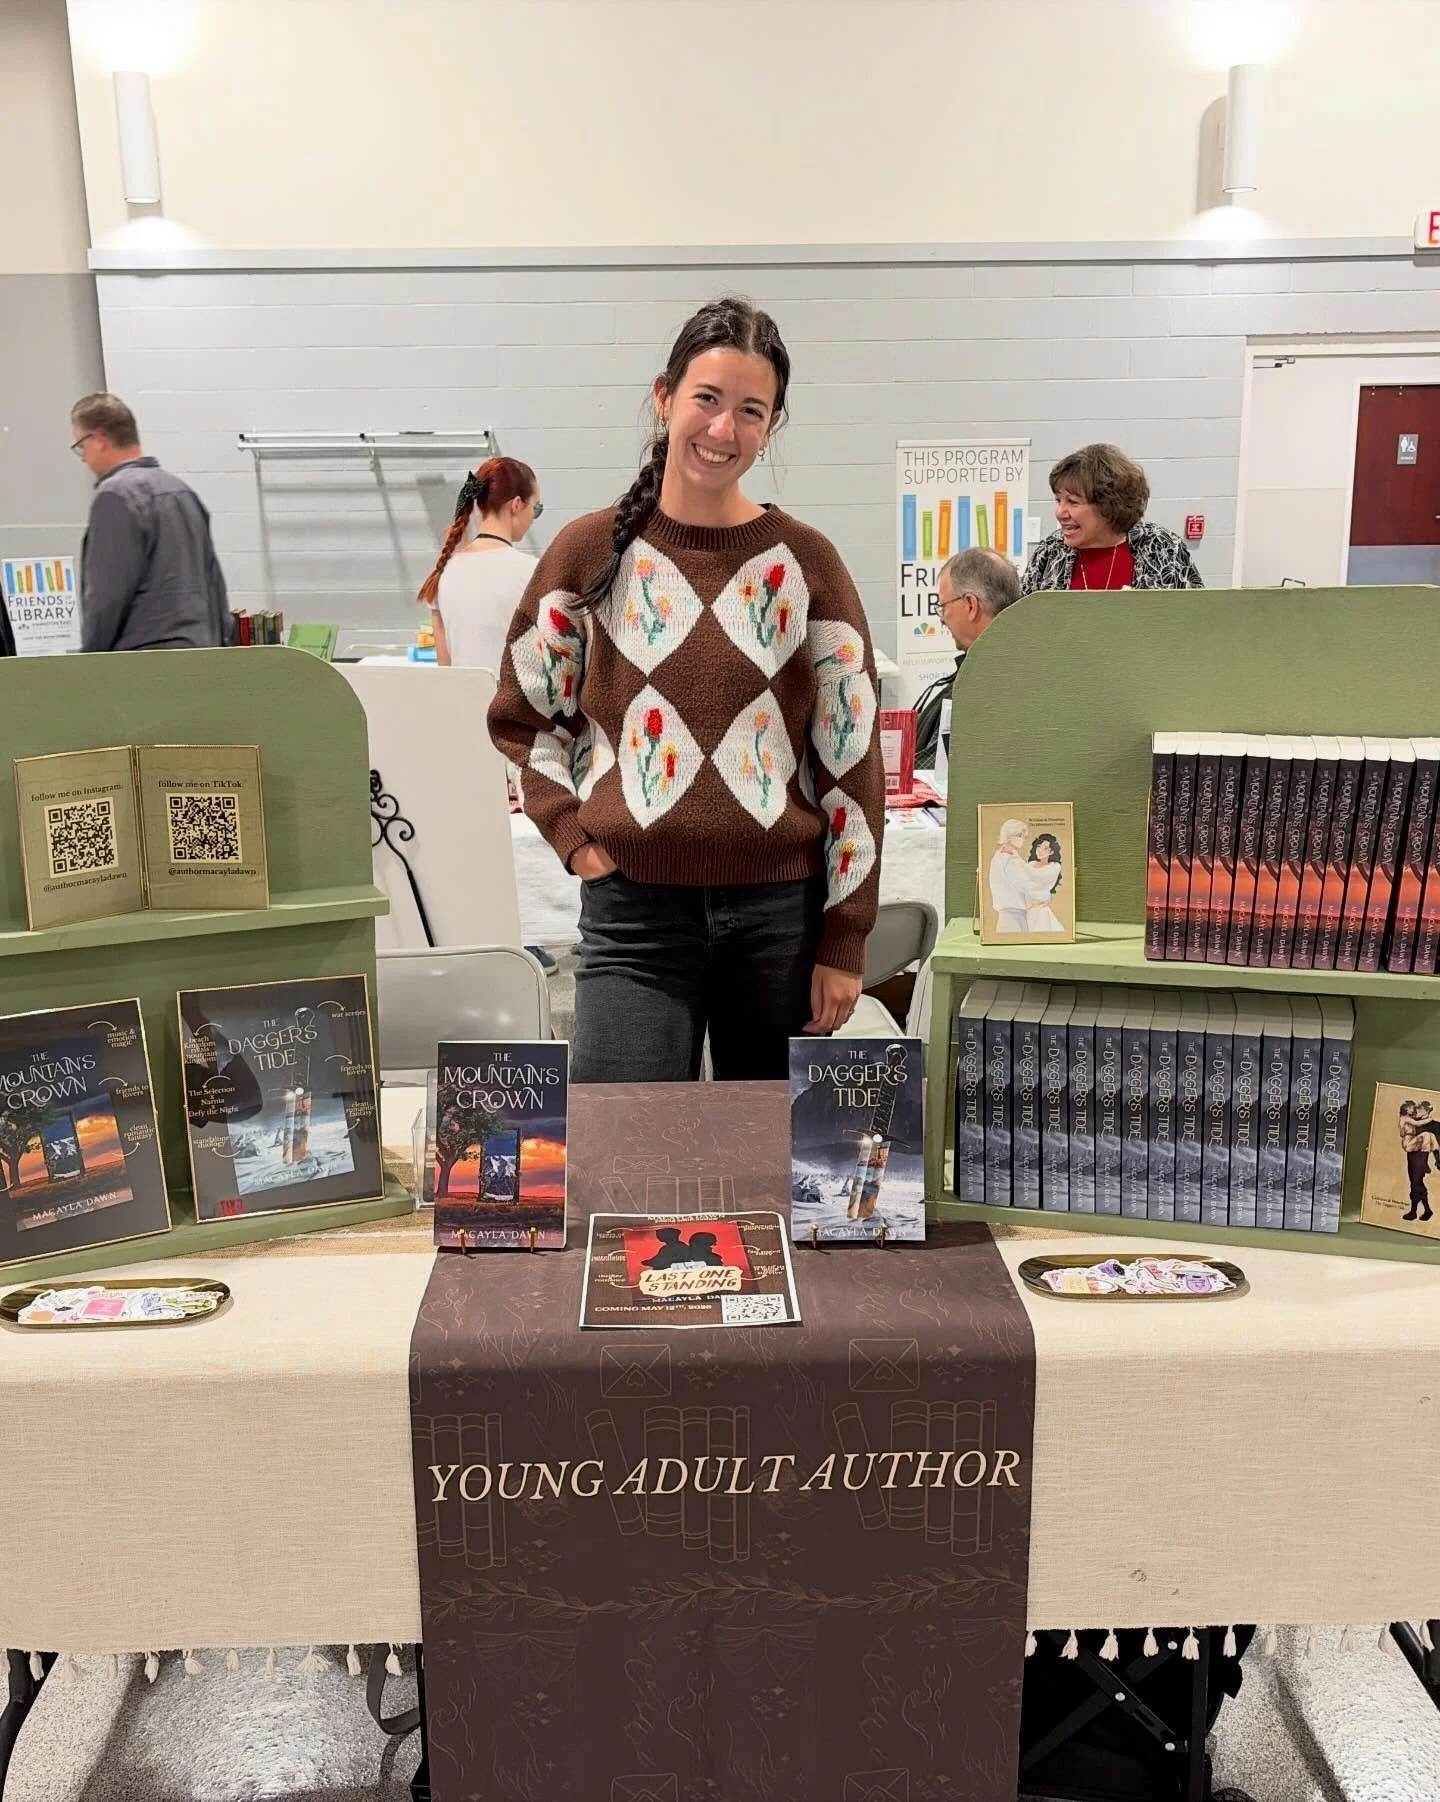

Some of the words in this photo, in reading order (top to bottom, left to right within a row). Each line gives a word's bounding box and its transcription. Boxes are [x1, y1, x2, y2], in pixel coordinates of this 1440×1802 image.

[904, 450, 940, 467] THIS
[944, 449, 1024, 465] PROGRAM
[903, 467, 1000, 485] SUPPORTED
[1006, 466, 1025, 482] BY
[8, 594, 63, 607] FRIENDS
[9, 607, 74, 622] LIBRARY
[158, 780, 184, 788] follow
[31, 792, 56, 802] follow
[168, 867, 257, 876] @authormacayladawn
[263, 1018, 280, 1028] THE
[107, 1031, 127, 1039] music
[107, 1034, 137, 1044] emotion
[111, 1040, 133, 1048] magic
[32, 1051, 50, 1063] THE
[254, 1048, 298, 1071] TIDE
[493, 1052, 513, 1062] THE
[848, 1050, 868, 1060] THE
[340, 1063, 361, 1073] friends
[444, 1063, 560, 1088] MOUNTAIN'S
[808, 1061, 908, 1086] DAGGER'S
[8, 1076, 88, 1110] CROWN
[115, 1085, 140, 1096] friends
[122, 1090, 144, 1099] lovers
[188, 1089, 203, 1097] The
[204, 1086, 236, 1095] Selection
[833, 1087, 881, 1107] TIDE
[456, 1086, 544, 1113] CROWN
[188, 1109, 206, 1118] Defy
[220, 1105, 240, 1114] Night
[964, 1098, 977, 1129] TIDE
[991, 1103, 1004, 1130] TIDE
[1020, 1103, 1034, 1130] TIDE
[1047, 1106, 1060, 1134] TIDE
[1073, 1109, 1087, 1137] TIDE
[1101, 1109, 1115, 1138] TIDE
[123, 1127, 155, 1137] romantic
[129, 1124, 148, 1132] clean
[1128, 1113, 1142, 1143] TIDE
[1155, 1115, 1170, 1144] TIDE
[1181, 1115, 1196, 1144] TIDE
[1208, 1120, 1224, 1149] TIDE
[1235, 1121, 1250, 1150] TIDE
[128, 1132, 153, 1142] fantasy
[1265, 1122, 1281, 1151] TIDE
[1294, 1123, 1310, 1152] TIDE
[1321, 1126, 1337, 1154] TIDE
[86, 1192, 117, 1206] DAWN
[645, 1272, 689, 1283] LAST
[700, 1268, 735, 1278] ONE
[648, 1277, 738, 1292] STANDING
[652, 1295, 702, 1303] MACAYLA
[427, 1458, 606, 1504] YOUNG
[612, 1454, 796, 1497] ADULT
[800, 1448, 1022, 1494] AUTHOR
